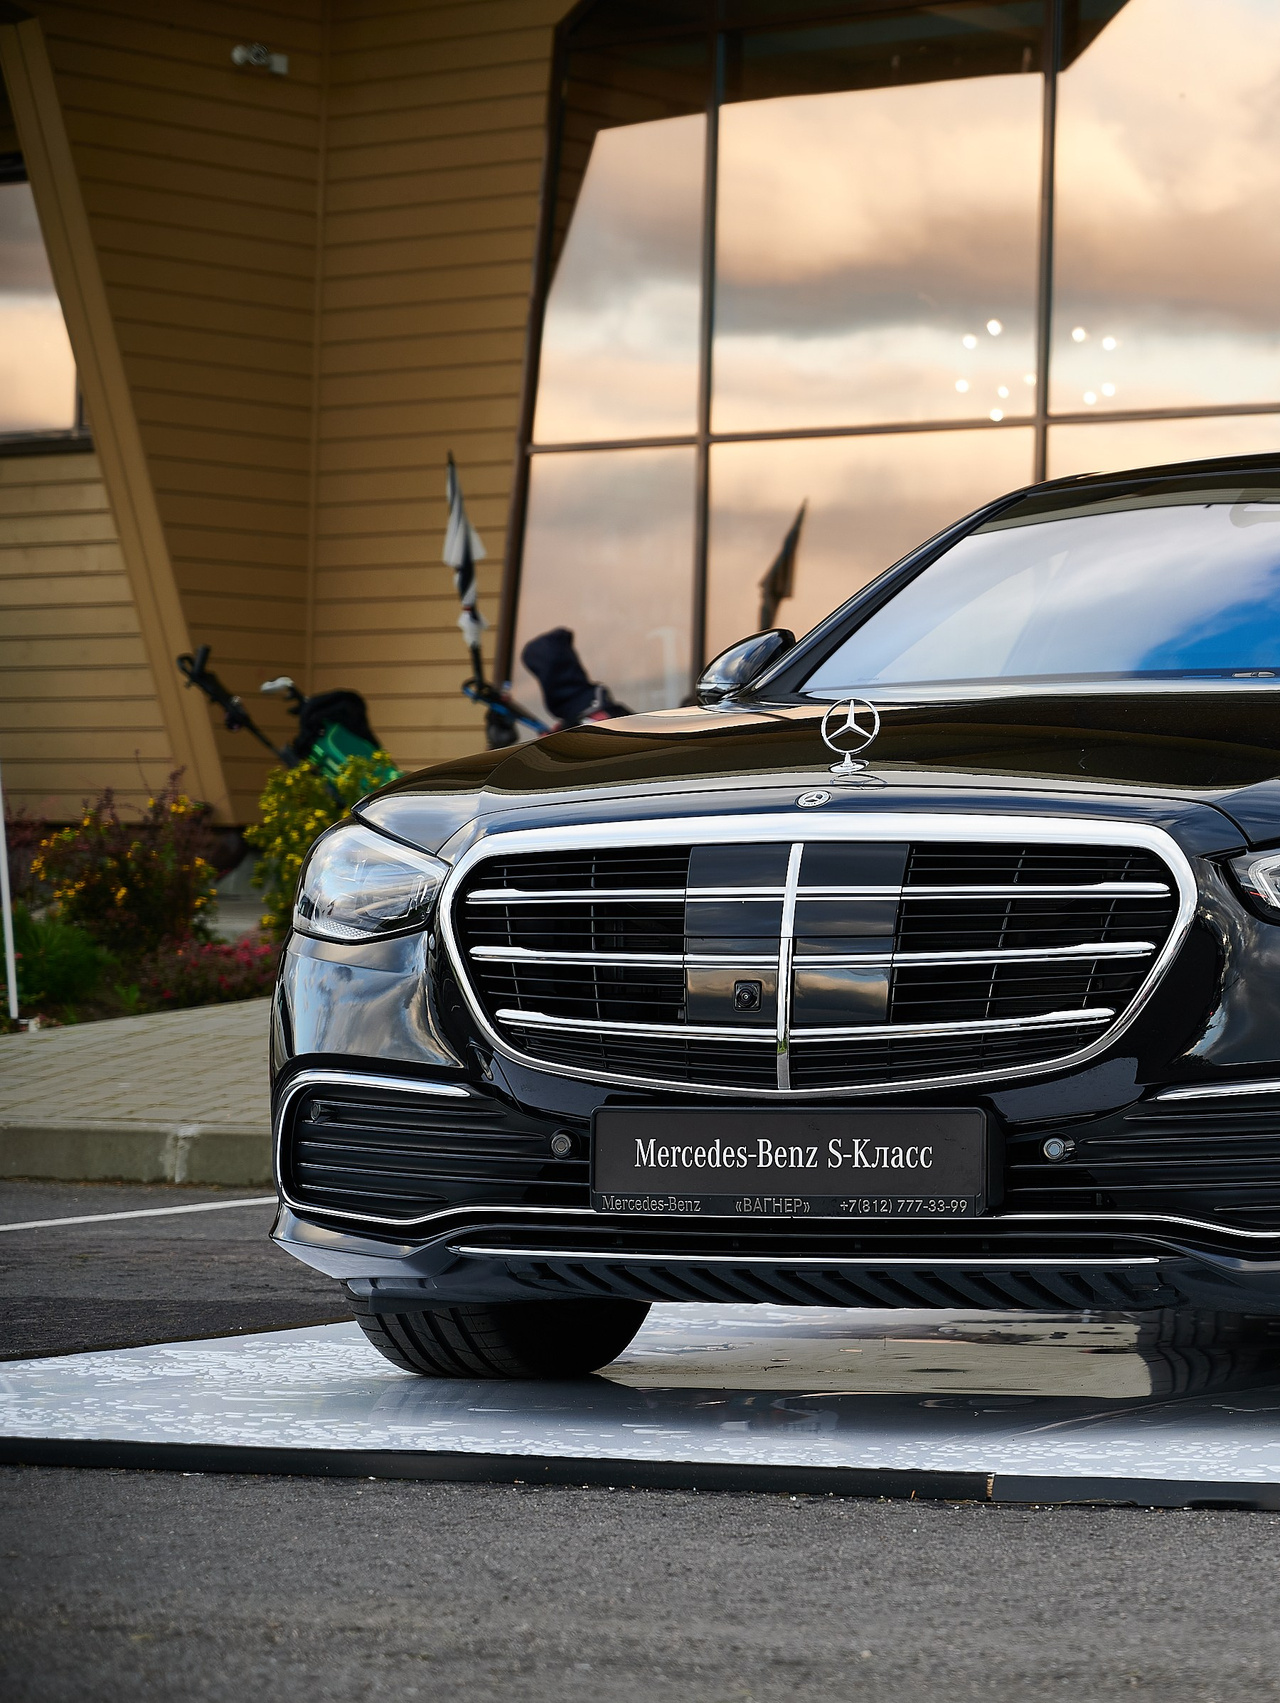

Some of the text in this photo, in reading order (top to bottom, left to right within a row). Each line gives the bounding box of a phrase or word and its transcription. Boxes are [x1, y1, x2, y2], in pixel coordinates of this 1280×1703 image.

[634, 1138, 933, 1169] Mercedes-Benz S-Класс
[602, 1195, 968, 1214] Mercedes-Benz «ВАГНЕР» +7(812) 777-33-99
